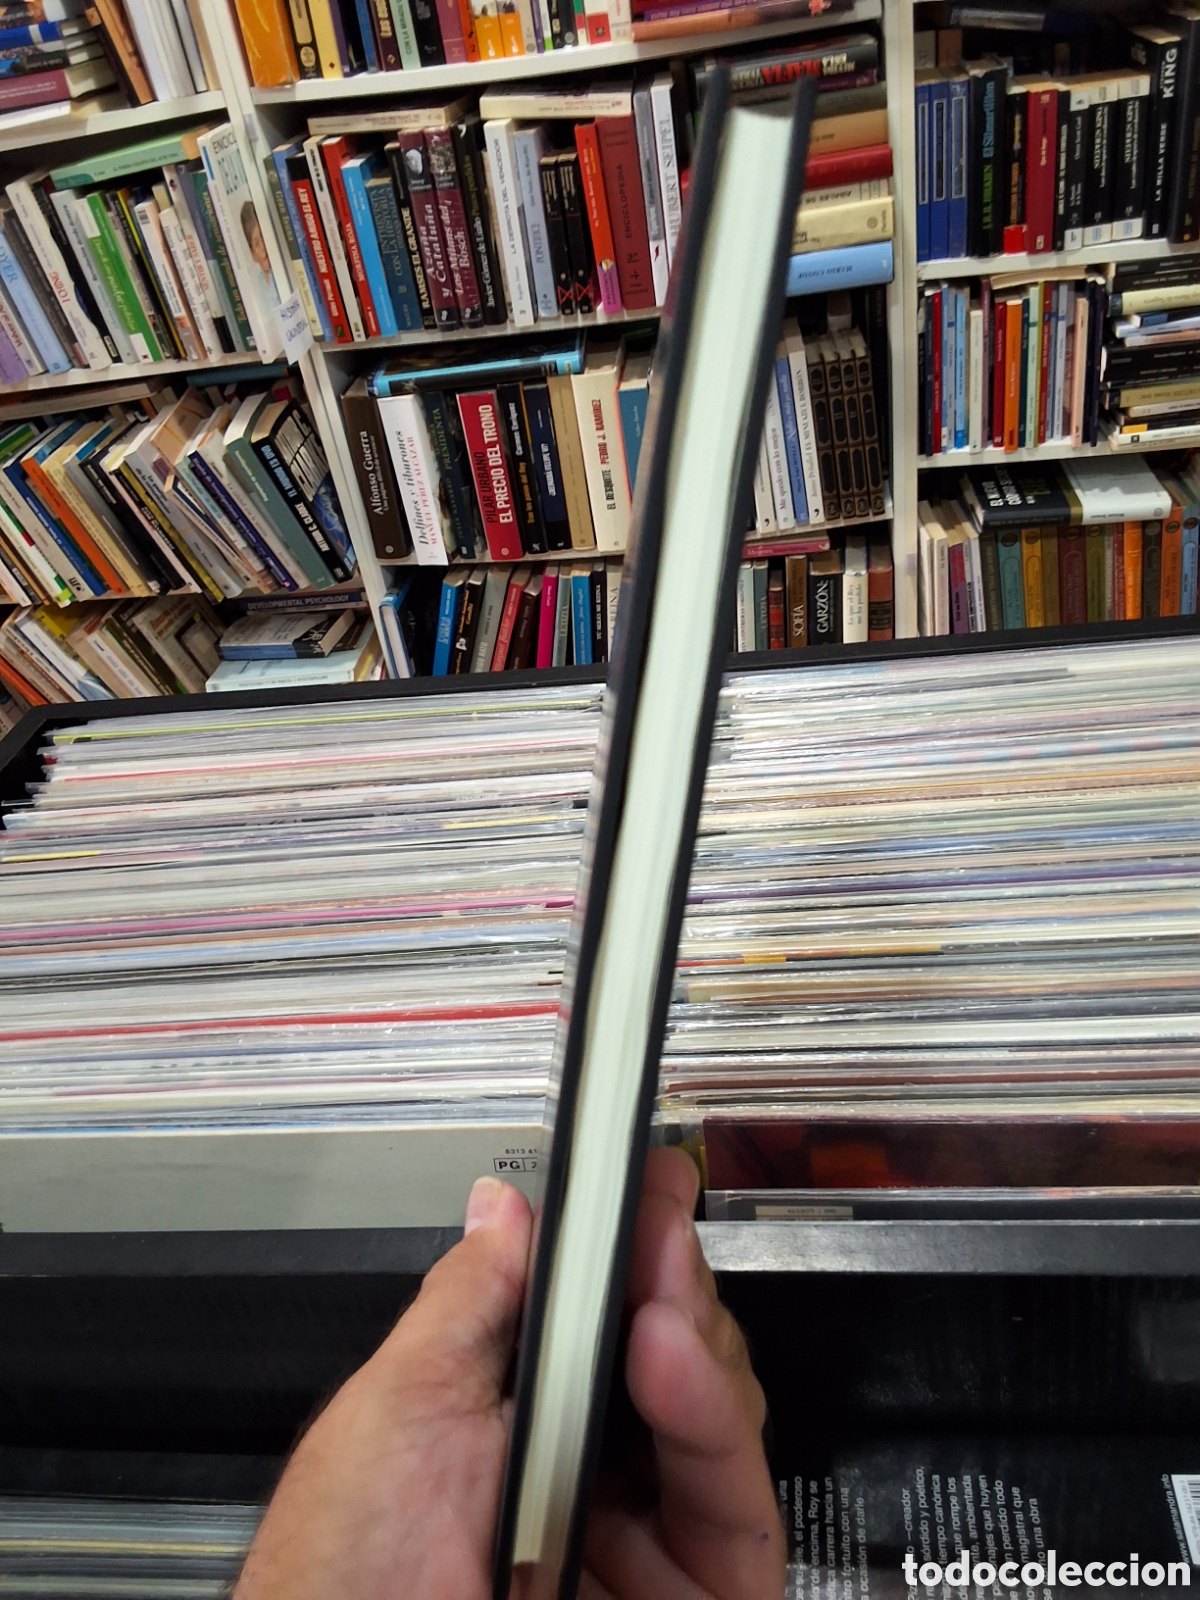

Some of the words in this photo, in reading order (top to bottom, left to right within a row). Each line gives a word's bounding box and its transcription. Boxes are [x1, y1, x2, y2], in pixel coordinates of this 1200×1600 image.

[1161, 46, 1177, 99] KING
[1158, 121, 1167, 154] VERDE
[492, 136, 508, 184] VENCEDOR
[1155, 156, 1164, 185] MILLA
[296, 184, 310, 204] REY
[500, 186, 510, 202] DEL
[614, 163, 633, 239] ENCICLOPEDIA
[304, 212, 319, 240] AMIGO
[344, 221, 356, 244] ROJA
[400, 205, 419, 252] GRANDE
[502, 204, 517, 242] DERROTA
[311, 238, 330, 274] NUESTRO
[409, 250, 421, 265] EL
[414, 223, 439, 281] Azaña
[418, 202, 450, 284] Cataluña
[349, 244, 365, 282] MORFINA
[47, 269, 68, 299] CHING
[412, 264, 432, 309] RAMSES
[477, 402, 499, 443] TRONO
[589, 398, 606, 432] RAMÍREZ
[259, 442, 276, 460] UNO
[354, 428, 376, 472] Guerra
[430, 406, 454, 470] PRESIDENTA
[510, 429, 524, 456] Carmen
[596, 440, 610, 464] PEDRO
[769, 426, 781, 448] mejor
[267, 456, 281, 469] ES
[390, 428, 416, 488] tiburones
[403, 434, 423, 477] ALCÁZAR
[485, 443, 503, 467] DEL
[272, 464, 294, 491] MUNDO
[472, 450, 492, 493] URBANO
[600, 467, 616, 501] DESQUITE
[774, 473, 787, 497] quedo
[286, 486, 298, 498] EL
[363, 471, 386, 516] Alfonso
[414, 478, 430, 508] PÉREZ
[489, 466, 511, 510] PRECIO
[292, 499, 314, 525] CLARKE
[481, 494, 499, 525] PILAR
[497, 509, 514, 524] EL
[776, 498, 786, 510] Me
[306, 521, 318, 532] C.
[407, 497, 432, 547] Delfines
[423, 511, 439, 544] MANUEL
[310, 527, 331, 553] ARTHUR
[247, 597, 304, 610] DEVELOPMENTAL
[305, 594, 350, 605] PSYCHOLOGY
[558, 603, 571, 637] LETIZIA
[788, 602, 806, 637] SOFÍA
[498, 1160, 520, 1171] PG
[824, 1477, 834, 1491] un
[840, 1487, 849, 1508] una
[916, 1466, 929, 1508] poético,
[932, 1474, 944, 1523] canónica
[948, 1477, 958, 1493] los
[978, 1475, 991, 1507] huyen
[994, 1480, 1006, 1505] todo
[1012, 1487, 1024, 1508] que
[794, 1476, 804, 1527] poderoso
[808, 1495, 820, 1518] Roy
[824, 1494, 835, 1524] hacia
[854, 1497, 866, 1526] darle
[950, 1494, 962, 1530] rompe
[963, 1475, 978, 1539] ambientada
[1029, 1498, 1040, 1524] obra
[841, 1512, 850, 1532] con
[855, 1528, 866, 1543] de
[981, 1510, 994, 1531] que
[998, 1507, 1013, 1550] perdido
[825, 1526, 836, 1566] carrera
[920, 1520, 932, 1561] sórdido
[936, 1526, 948, 1564] tiempo
[1014, 1510, 1030, 1563] magistral
[1033, 1527, 1044, 1548] una
[841, 1535, 853, 1576] fortuito
[857, 1546, 869, 1592] ocasión
